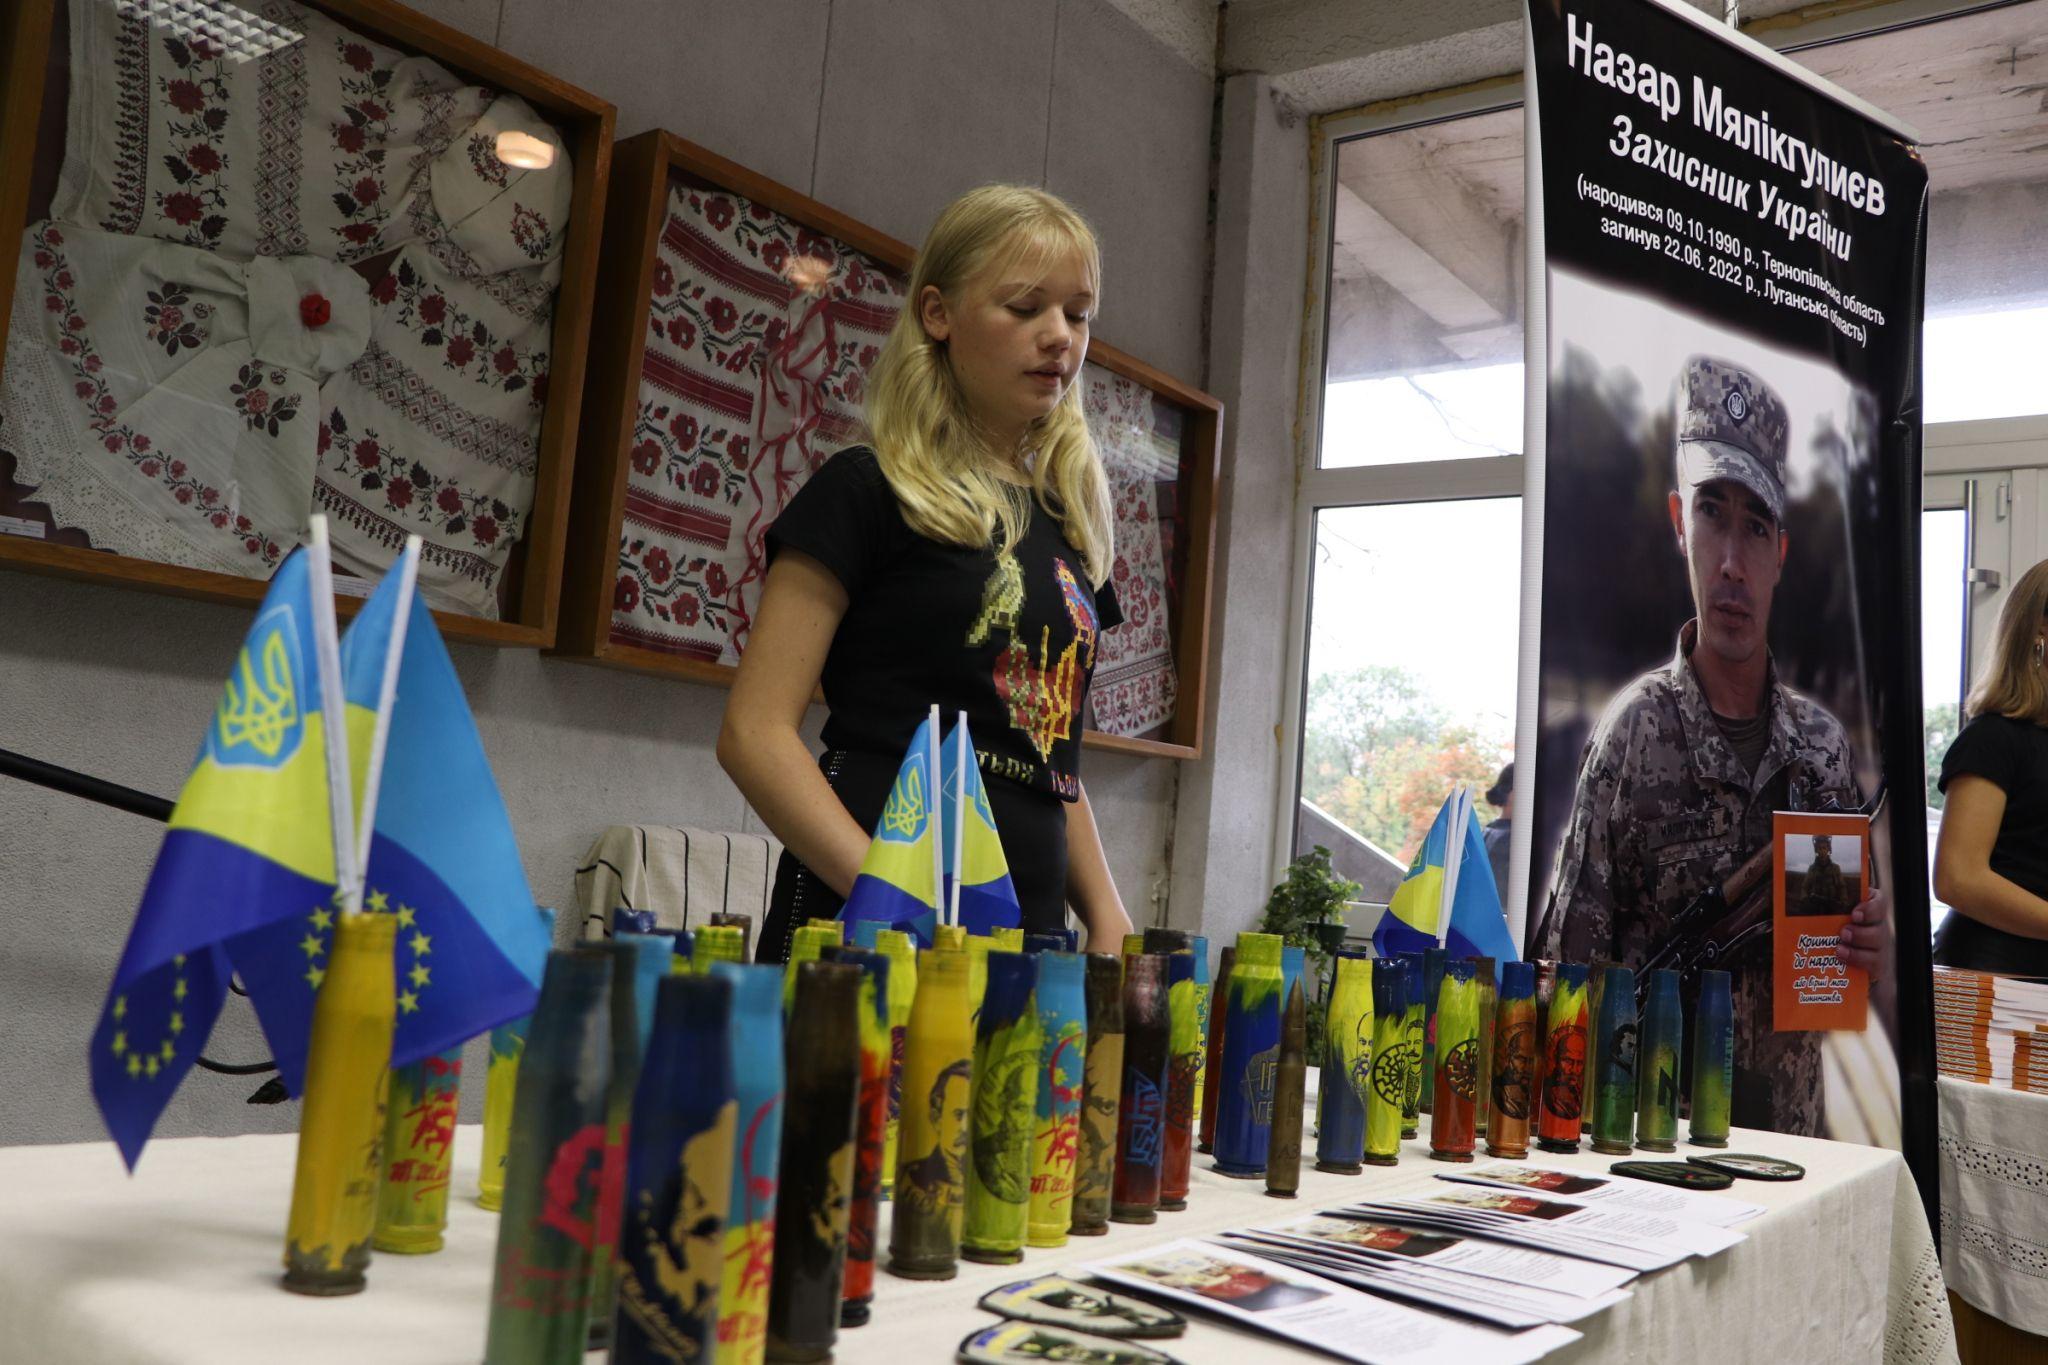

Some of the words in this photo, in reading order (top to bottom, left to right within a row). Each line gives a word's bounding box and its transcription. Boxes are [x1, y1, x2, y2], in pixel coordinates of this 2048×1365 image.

[1567, 13, 1681, 122] Назар
[1693, 75, 1886, 216] Мялікгулиєв
[1609, 114, 1751, 212] Захисник
[1757, 180, 1852, 262] України
[1577, 173, 1664, 224] (народився
[1666, 208, 1741, 258] 09.10.1990
[1744, 247, 1759, 269] р.,
[1762, 250, 1841, 305] Тернопільська
[1842, 295, 1885, 326] область
[1600, 217, 1661, 250] загинув
[1664, 235, 1704, 275] 22.06.
[1708, 253, 1742, 286] 2022
[1745, 275, 1761, 297] р.,
[1764, 278, 1829, 318] Луганська
[1829, 308, 1867, 348] область)
